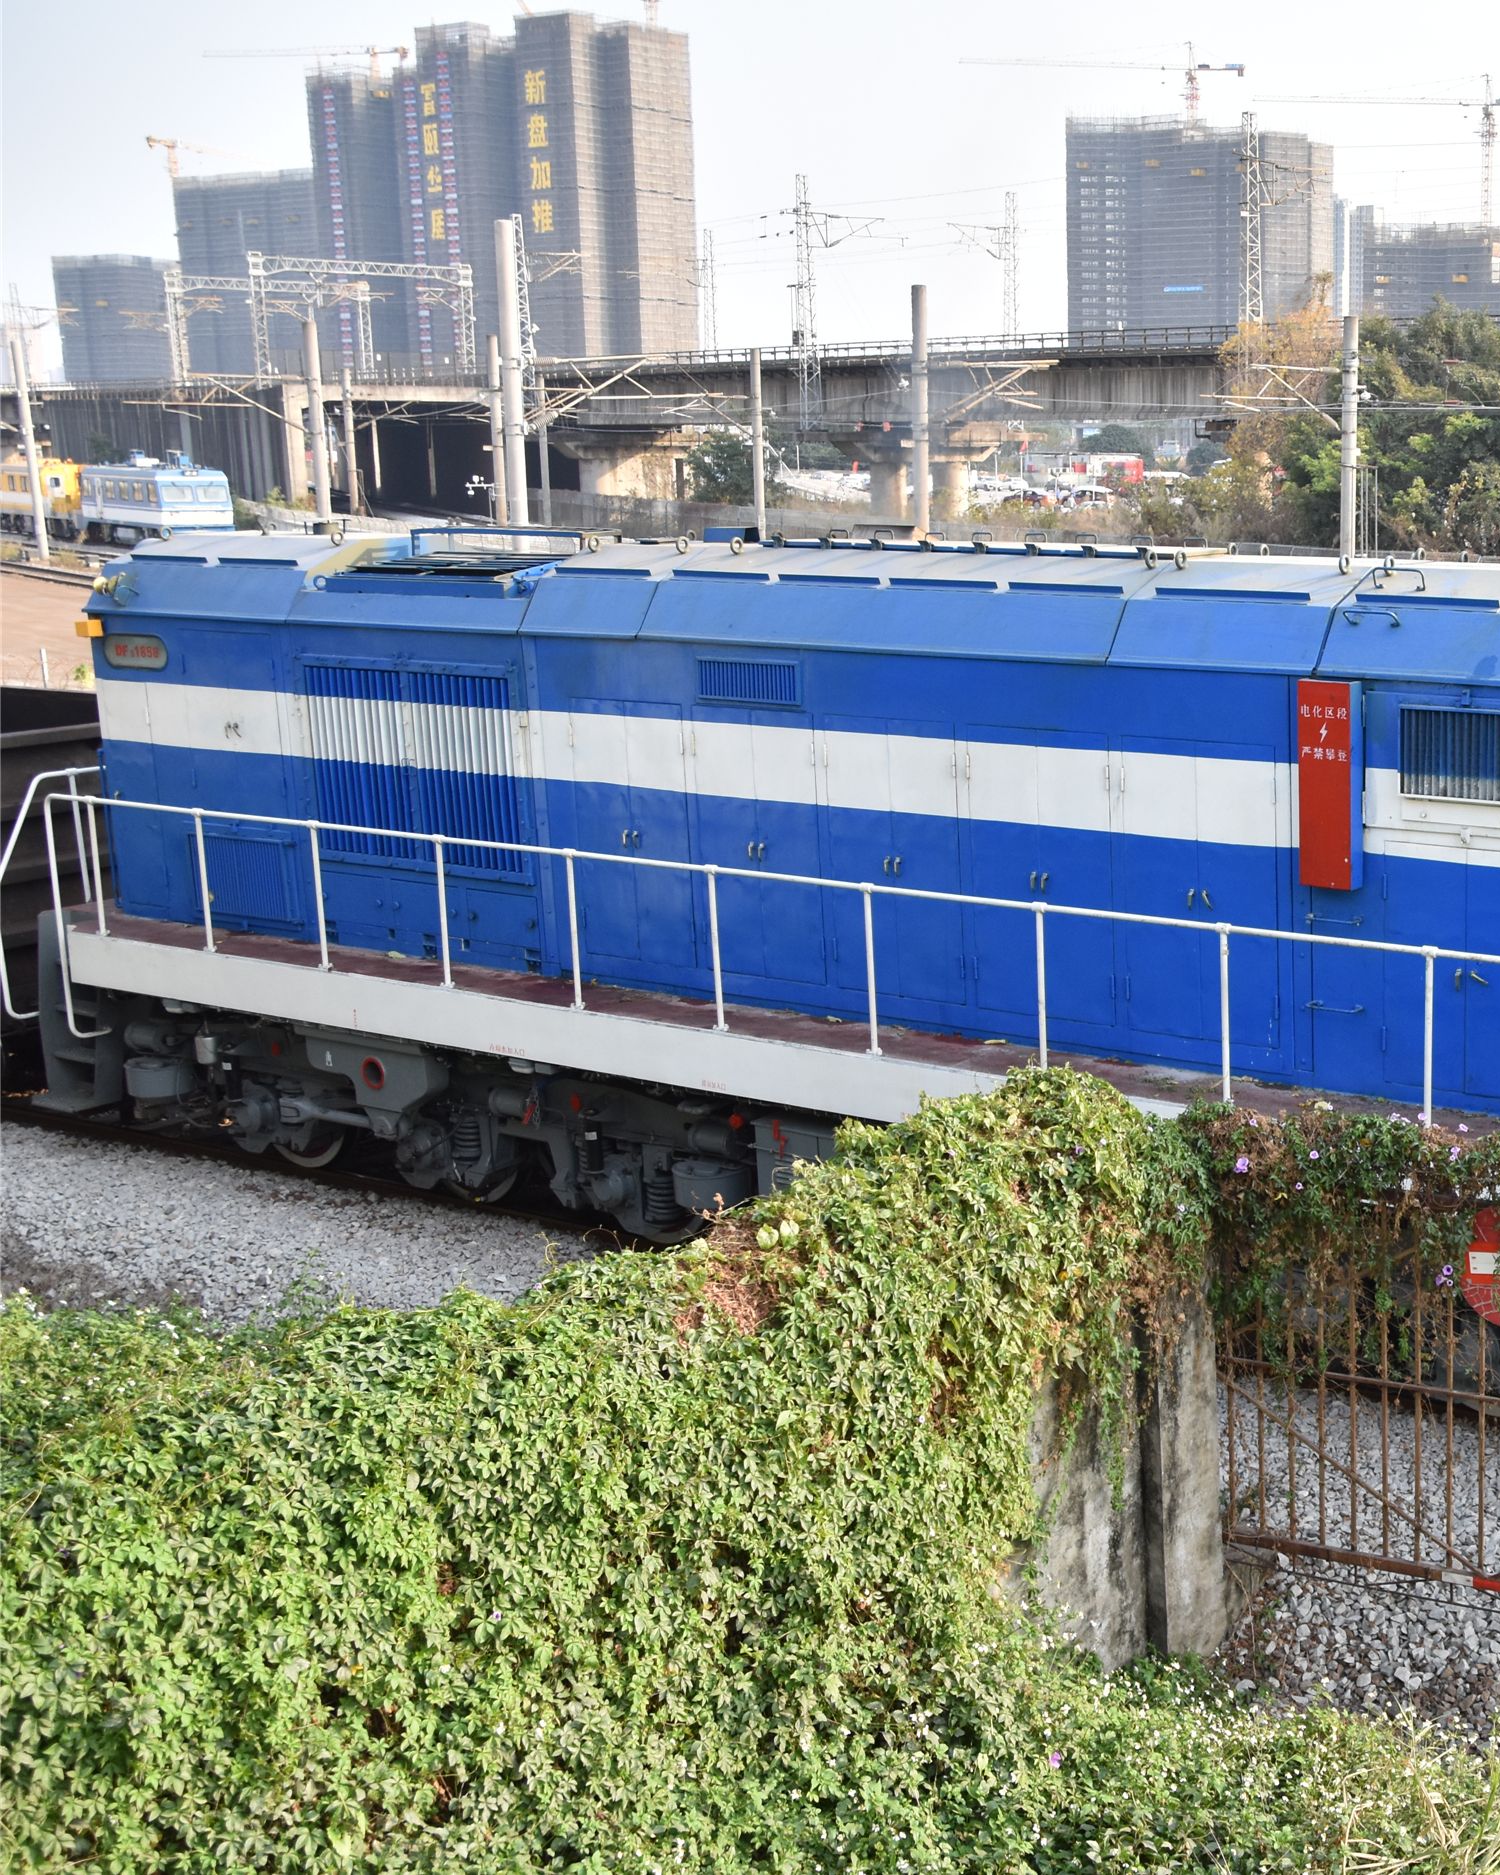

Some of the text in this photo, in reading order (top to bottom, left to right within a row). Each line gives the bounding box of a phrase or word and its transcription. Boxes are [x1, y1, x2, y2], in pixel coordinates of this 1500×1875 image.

[524, 69, 554, 233] 新盘加推
[1300, 704, 1348, 720] 电化区段
[1301, 746, 1348, 762] 严禁攀登
